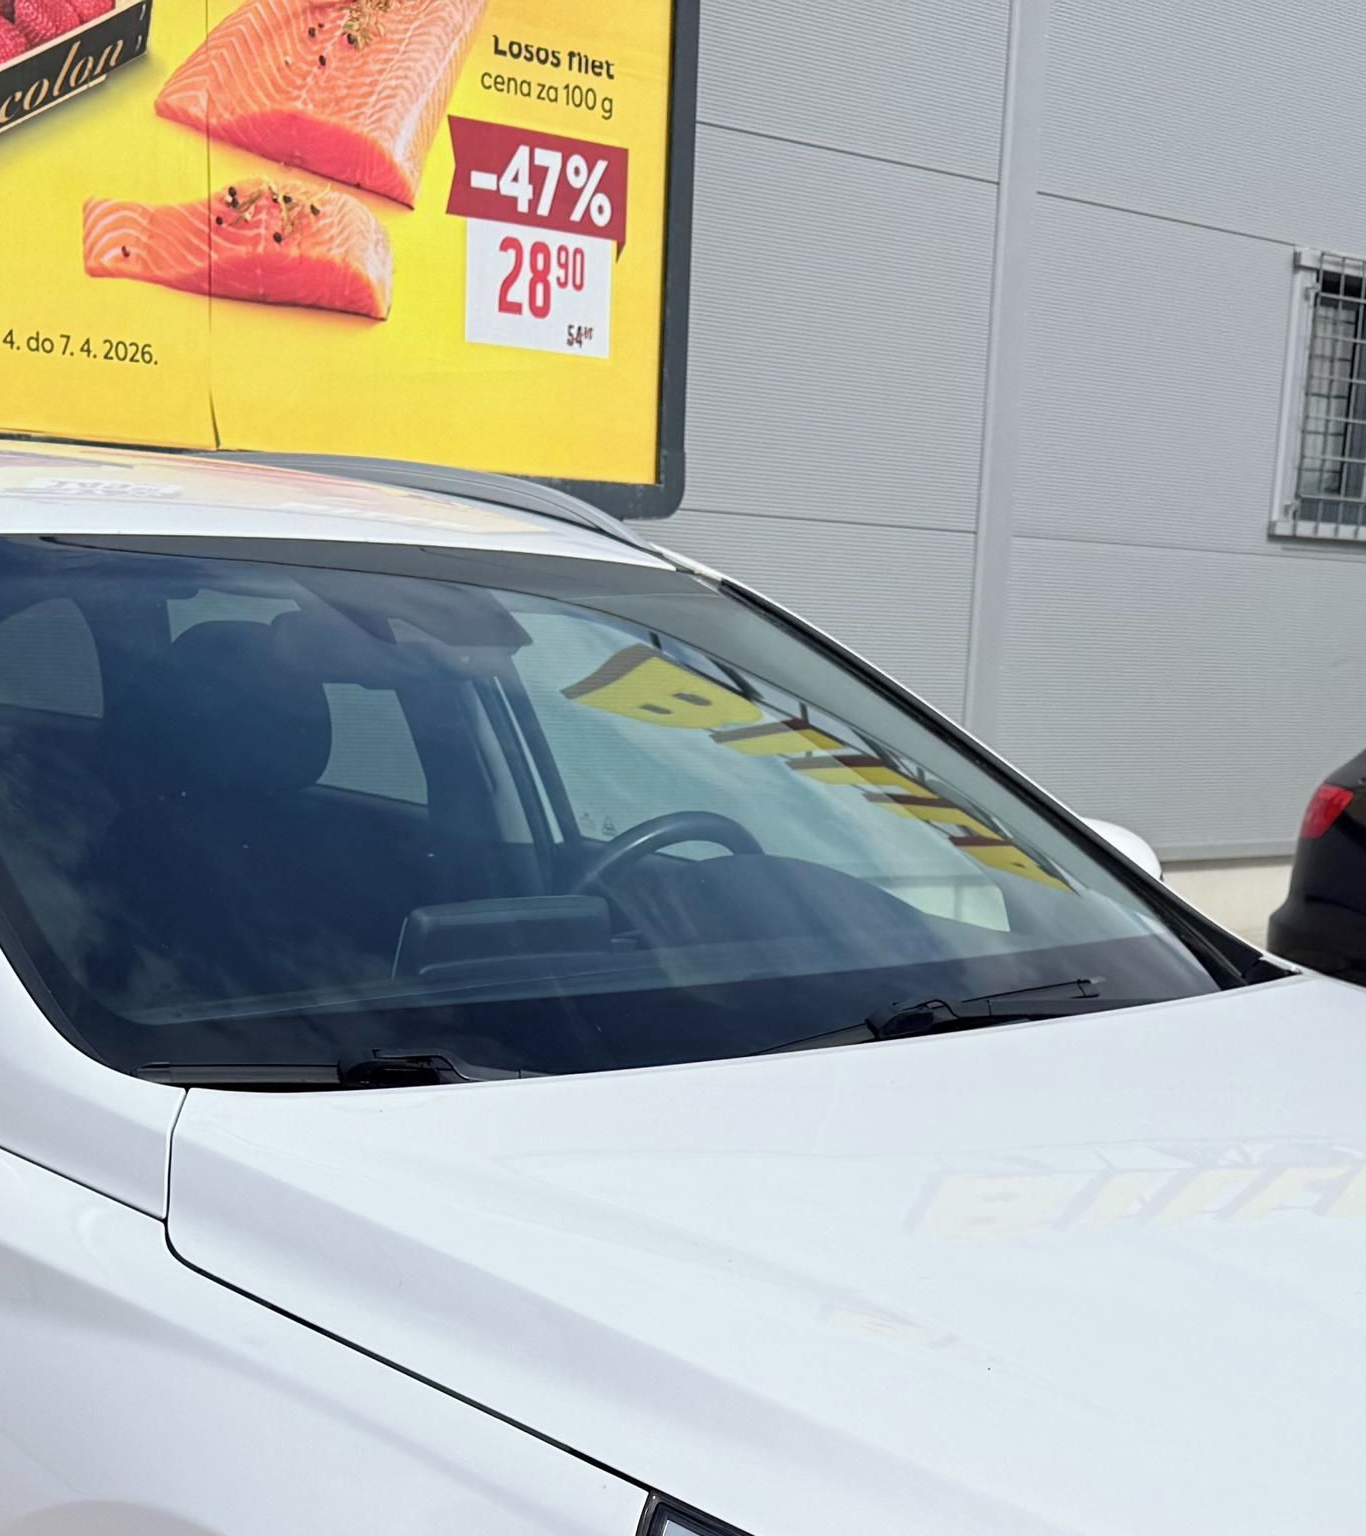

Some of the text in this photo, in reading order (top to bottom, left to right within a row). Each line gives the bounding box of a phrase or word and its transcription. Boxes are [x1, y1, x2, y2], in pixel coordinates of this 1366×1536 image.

[492, 34, 561, 68] Losos
[481, 72, 613, 120] cena za 100 g
[2, 329, 20, 350] 4.
[27, 332, 54, 353] do
[60, 335, 75, 356] 7.
[80, 338, 97, 358] 4.
[103, 340, 158, 366] 2026.
